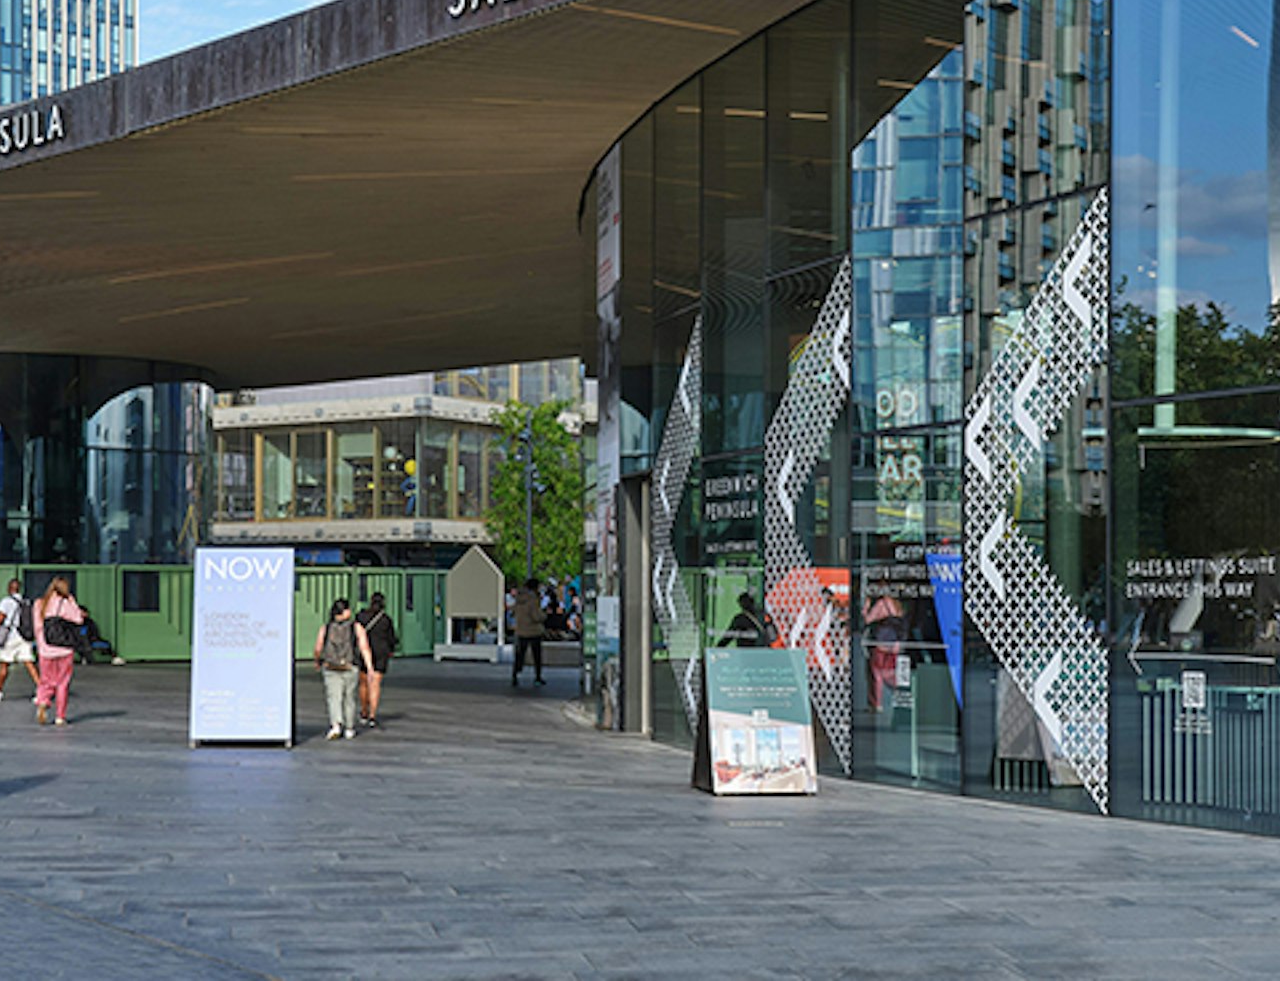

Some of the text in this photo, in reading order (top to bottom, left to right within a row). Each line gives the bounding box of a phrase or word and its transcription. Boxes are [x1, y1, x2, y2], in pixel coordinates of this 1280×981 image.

[204, 556, 284, 582] NOW
[1126, 558, 1162, 577] SALES
[1176, 557, 1236, 576] LETTINGS
[1238, 555, 1276, 574] SUITE
[1126, 581, 1255, 599] ENTRANCE THIS WAY
